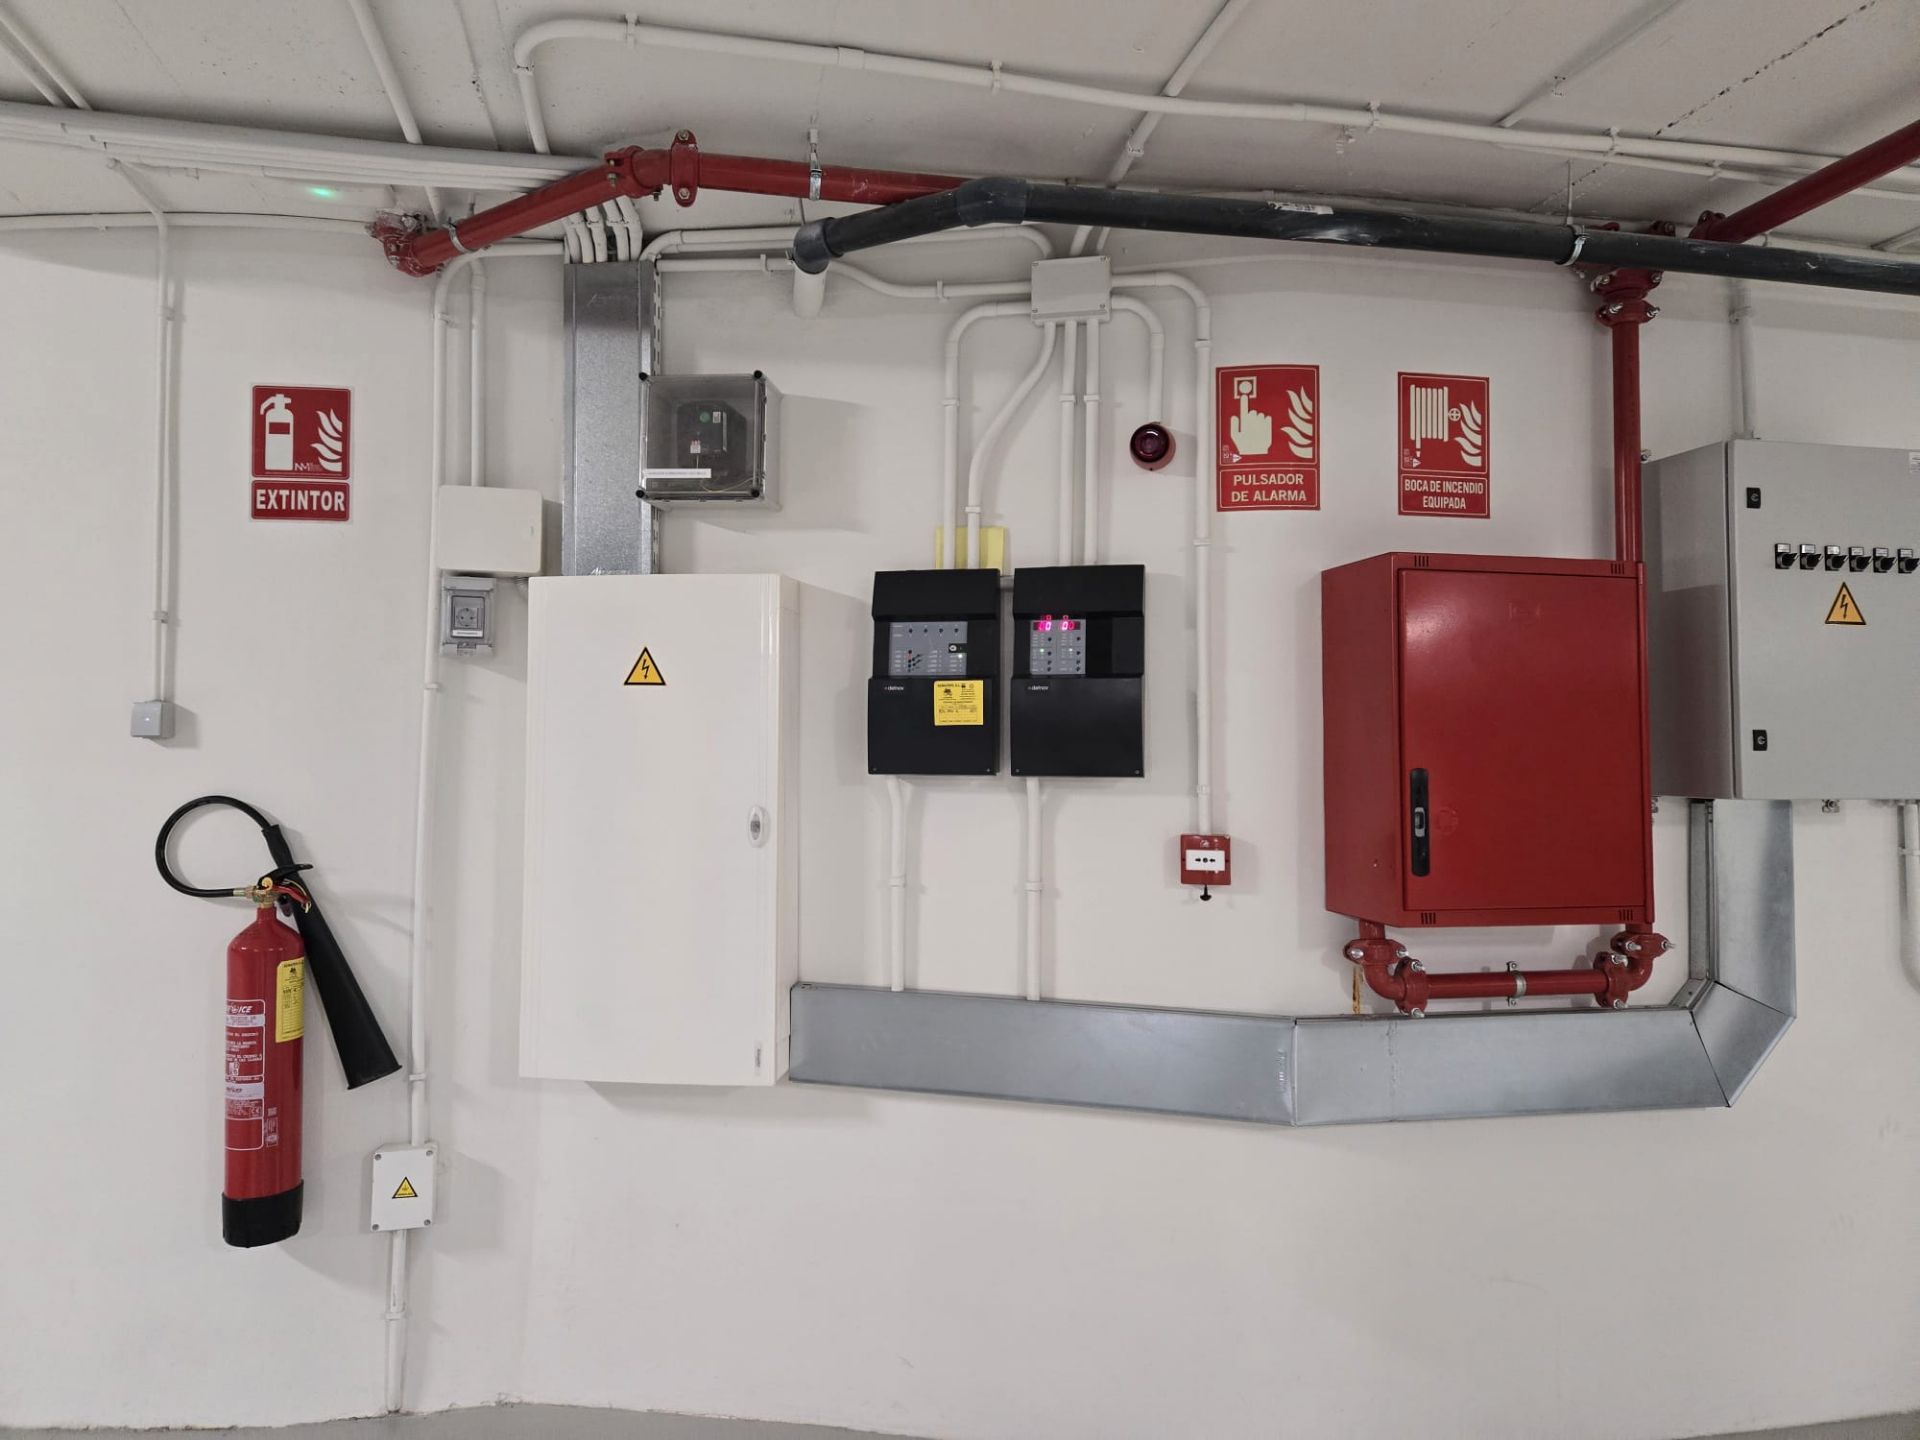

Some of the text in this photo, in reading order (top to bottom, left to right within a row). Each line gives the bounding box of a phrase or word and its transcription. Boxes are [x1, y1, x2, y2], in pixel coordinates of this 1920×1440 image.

[1233, 474, 1304, 486] PULSADOR
[1404, 479, 1484, 494] BOCA DE INCENDIO
[256, 489, 345, 512] EXTINTOR
[1231, 490, 1307, 502] DE ALARMA
[1423, 496, 1466, 509] EQUIPADA
